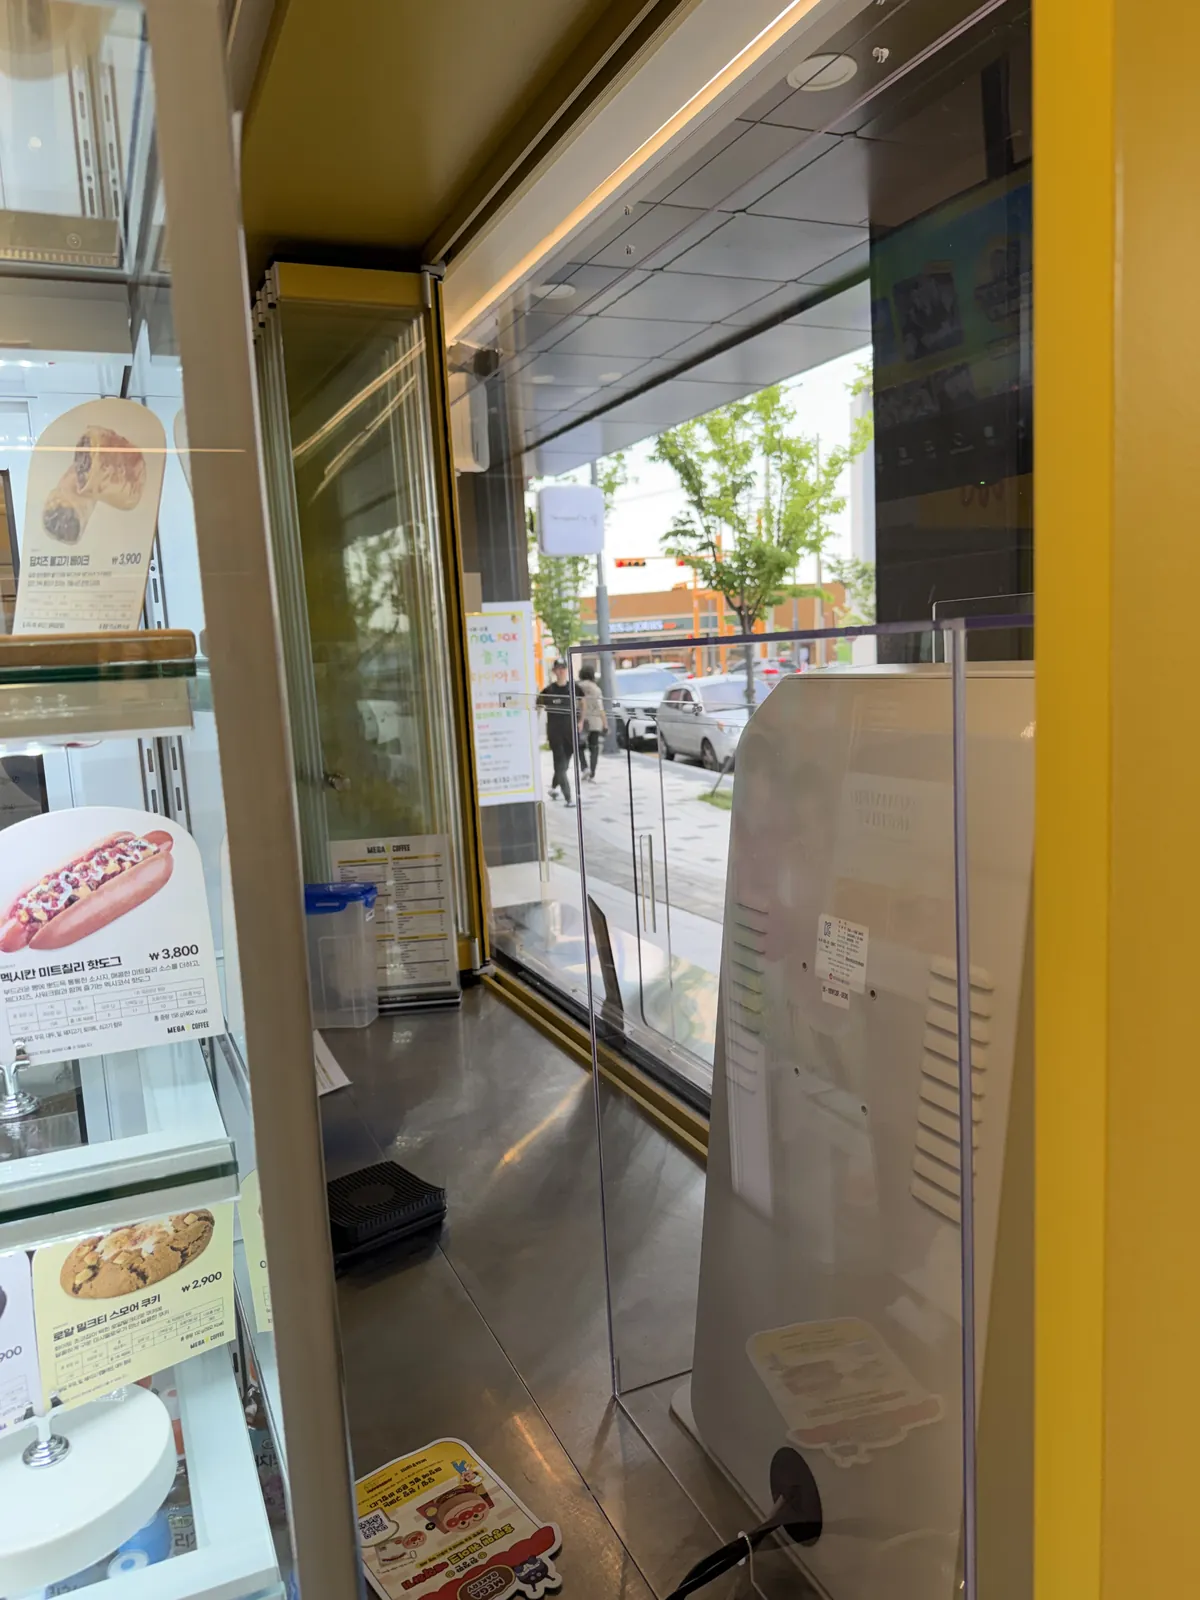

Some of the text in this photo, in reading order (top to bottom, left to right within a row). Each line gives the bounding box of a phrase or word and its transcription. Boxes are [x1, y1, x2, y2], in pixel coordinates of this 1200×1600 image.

[50, 556, 69, 567] 불고기
[70, 555, 90, 566] 베이크
[366, 844, 411, 854] MEGA COFFEE
[1, 955, 122, 984] 멕시칸 미트칠리 핫도그
[4, 986, 30, 996] 부드러운
[89, 973, 109, 983] 소시지,
[132, 966, 158, 976] 미트칠리
[159, 962, 178, 972] 소스를
[179, 959, 200, 969] 더하고,
[35, 988, 67, 999] 사워크림과
[83, 983, 102, 992] 즐기는
[104, 978, 130, 989] 멕시코식
[132, 975, 151, 984] 핫도그
[167, 1021, 209, 1034] MEGA COFFEE
[76, 1314, 107, 1333] 밀크티
[109, 1302, 139, 1321] 스모어
[141, 1293, 161, 1309] 쿠키
[190, 1331, 224, 1349] MEGA COFFEE
[395, 1484, 409, 1494] 문의
[383, 1495, 402, 1508] 구매는
[480, 1523, 514, 1546] 호빵맨
[447, 1542, 482, 1565] 케이크
[455, 1557, 478, 1573] 한정판
[467, 1570, 499, 1594] BAKERY
[471, 1577, 505, 1599] MEGA
